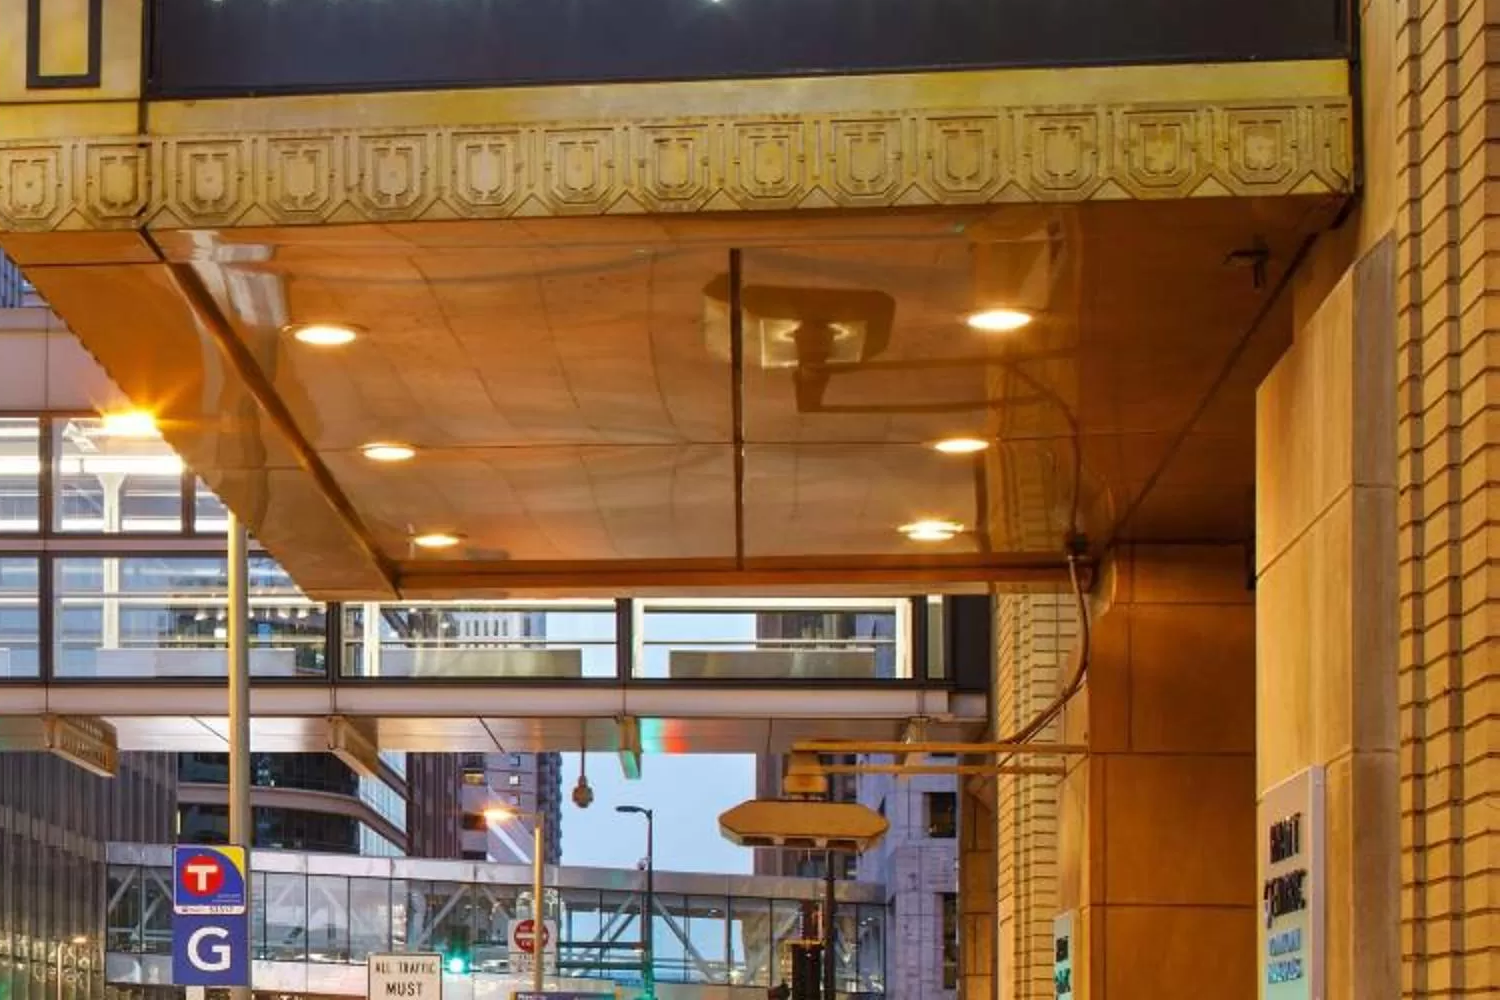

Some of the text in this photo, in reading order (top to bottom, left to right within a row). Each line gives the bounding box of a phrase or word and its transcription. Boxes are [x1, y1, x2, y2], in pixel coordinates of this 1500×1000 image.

[186, 864, 219, 892] T
[187, 925, 231, 972] G
[385, 981, 422, 997] MUST
